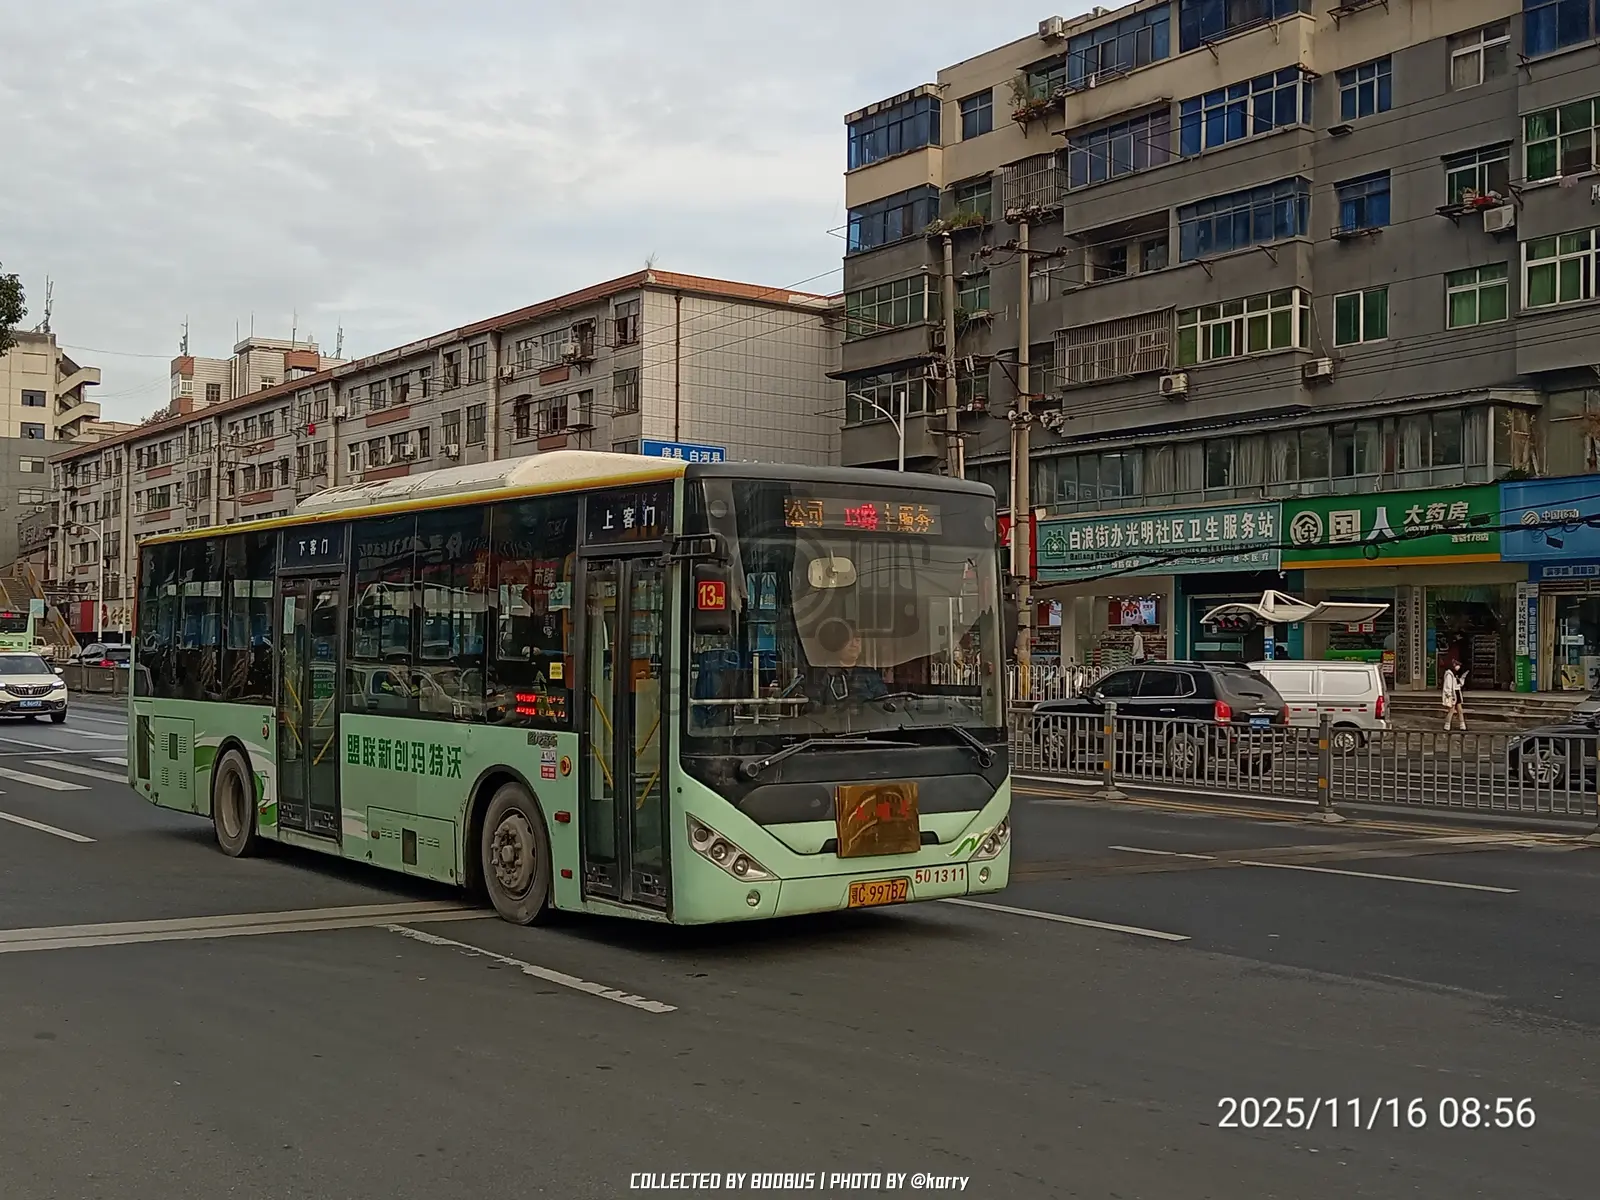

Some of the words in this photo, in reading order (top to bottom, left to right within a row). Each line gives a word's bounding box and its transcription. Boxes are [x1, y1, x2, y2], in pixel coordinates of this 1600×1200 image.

[662, 447, 683, 459] 房县
[689, 450, 721, 463] 白河县
[602, 505, 656, 530] 上客门
[1403, 501, 1469, 525] 大药房
[1069, 511, 1274, 551] 白浪街办光明社区卫生服务站
[299, 538, 328, 556] 下客门
[915, 867, 965, 884] 501311
